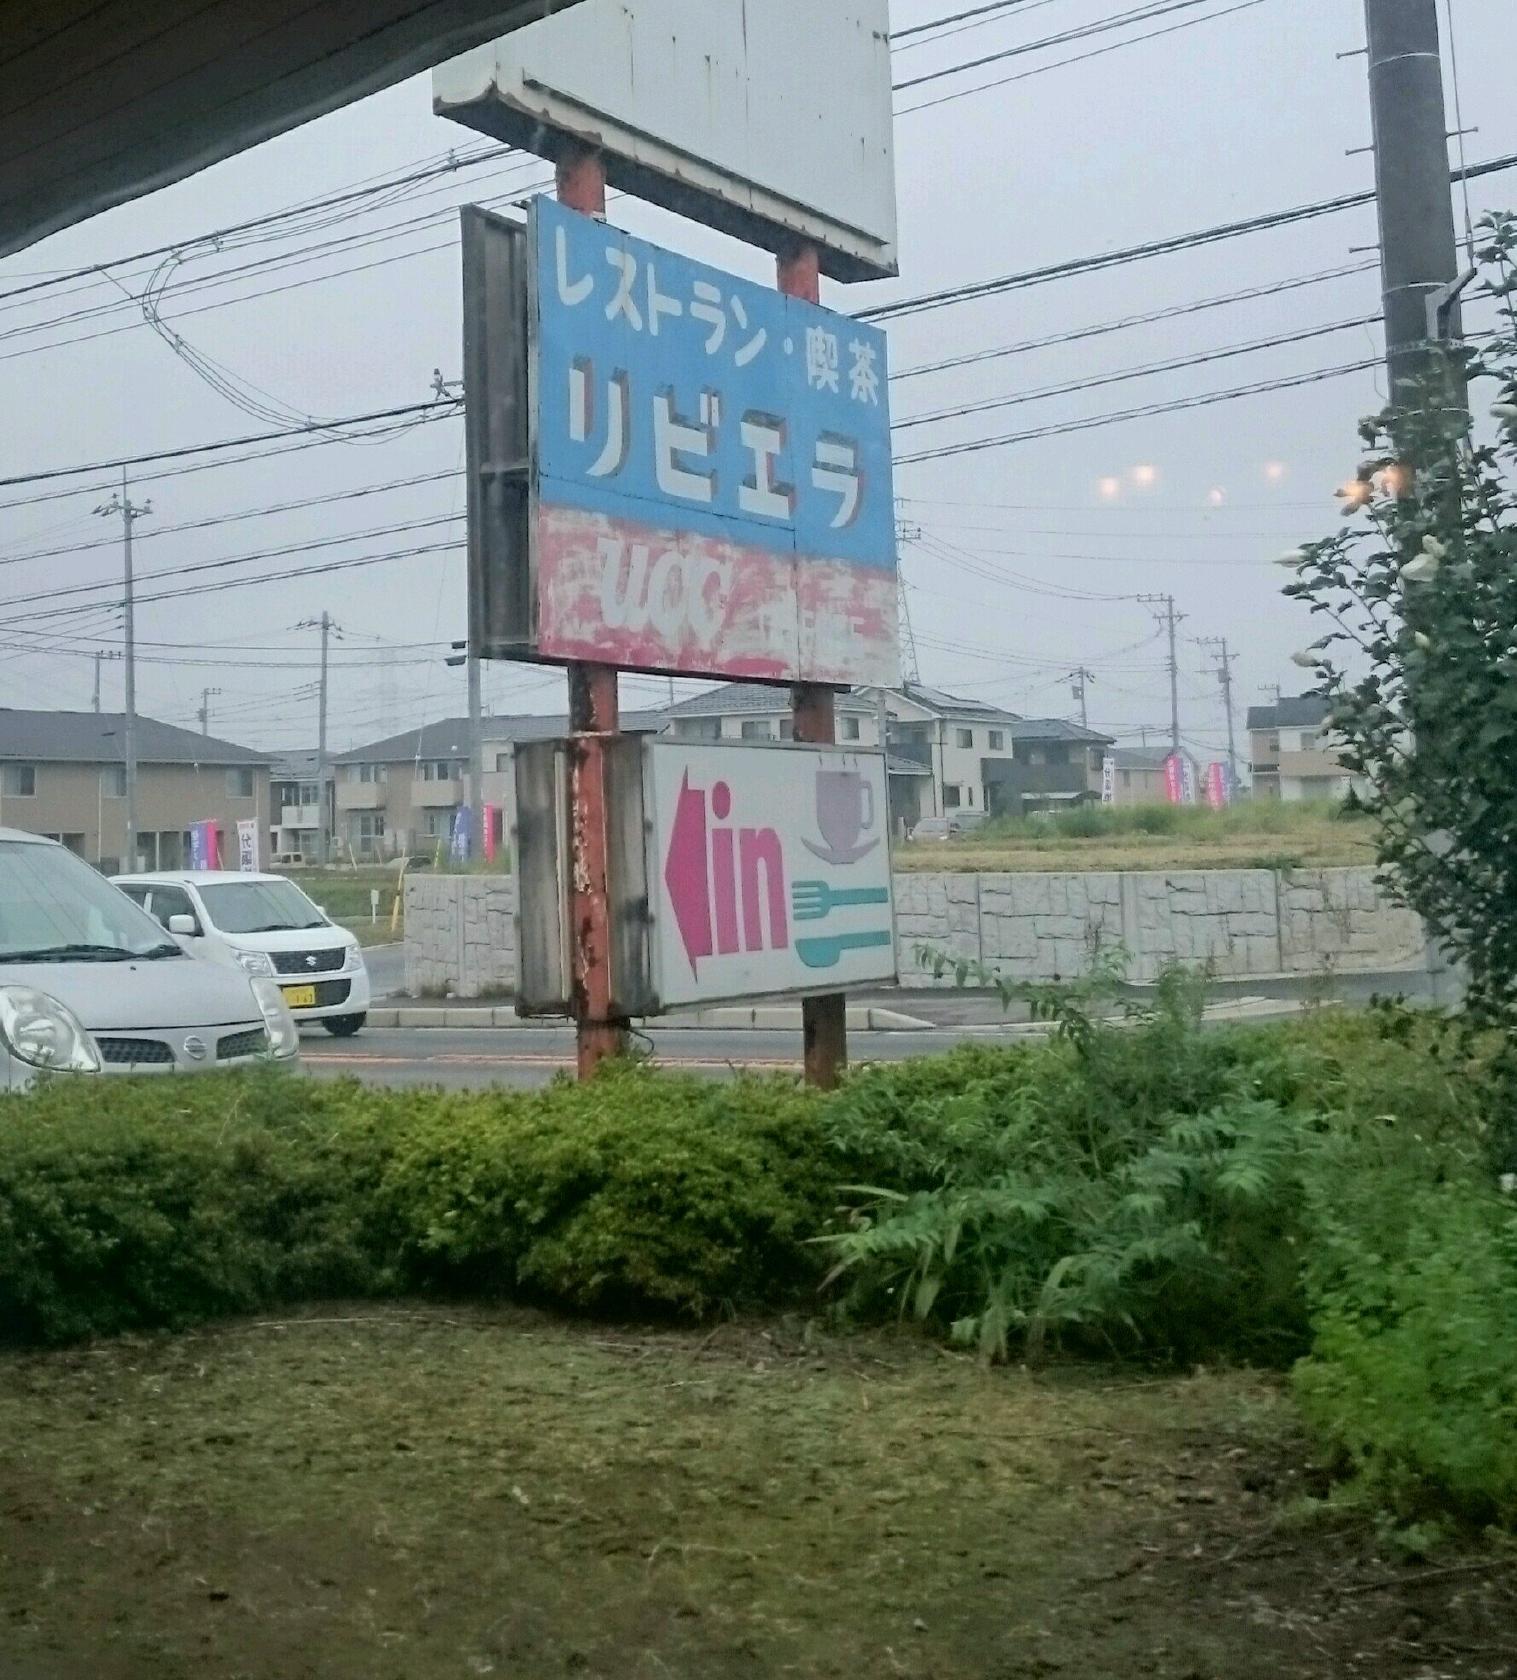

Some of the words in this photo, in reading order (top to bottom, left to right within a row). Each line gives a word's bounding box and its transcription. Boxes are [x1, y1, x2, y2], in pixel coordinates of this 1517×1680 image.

[568, 361, 862, 528] リビエラ
[712, 780, 788, 954] in
